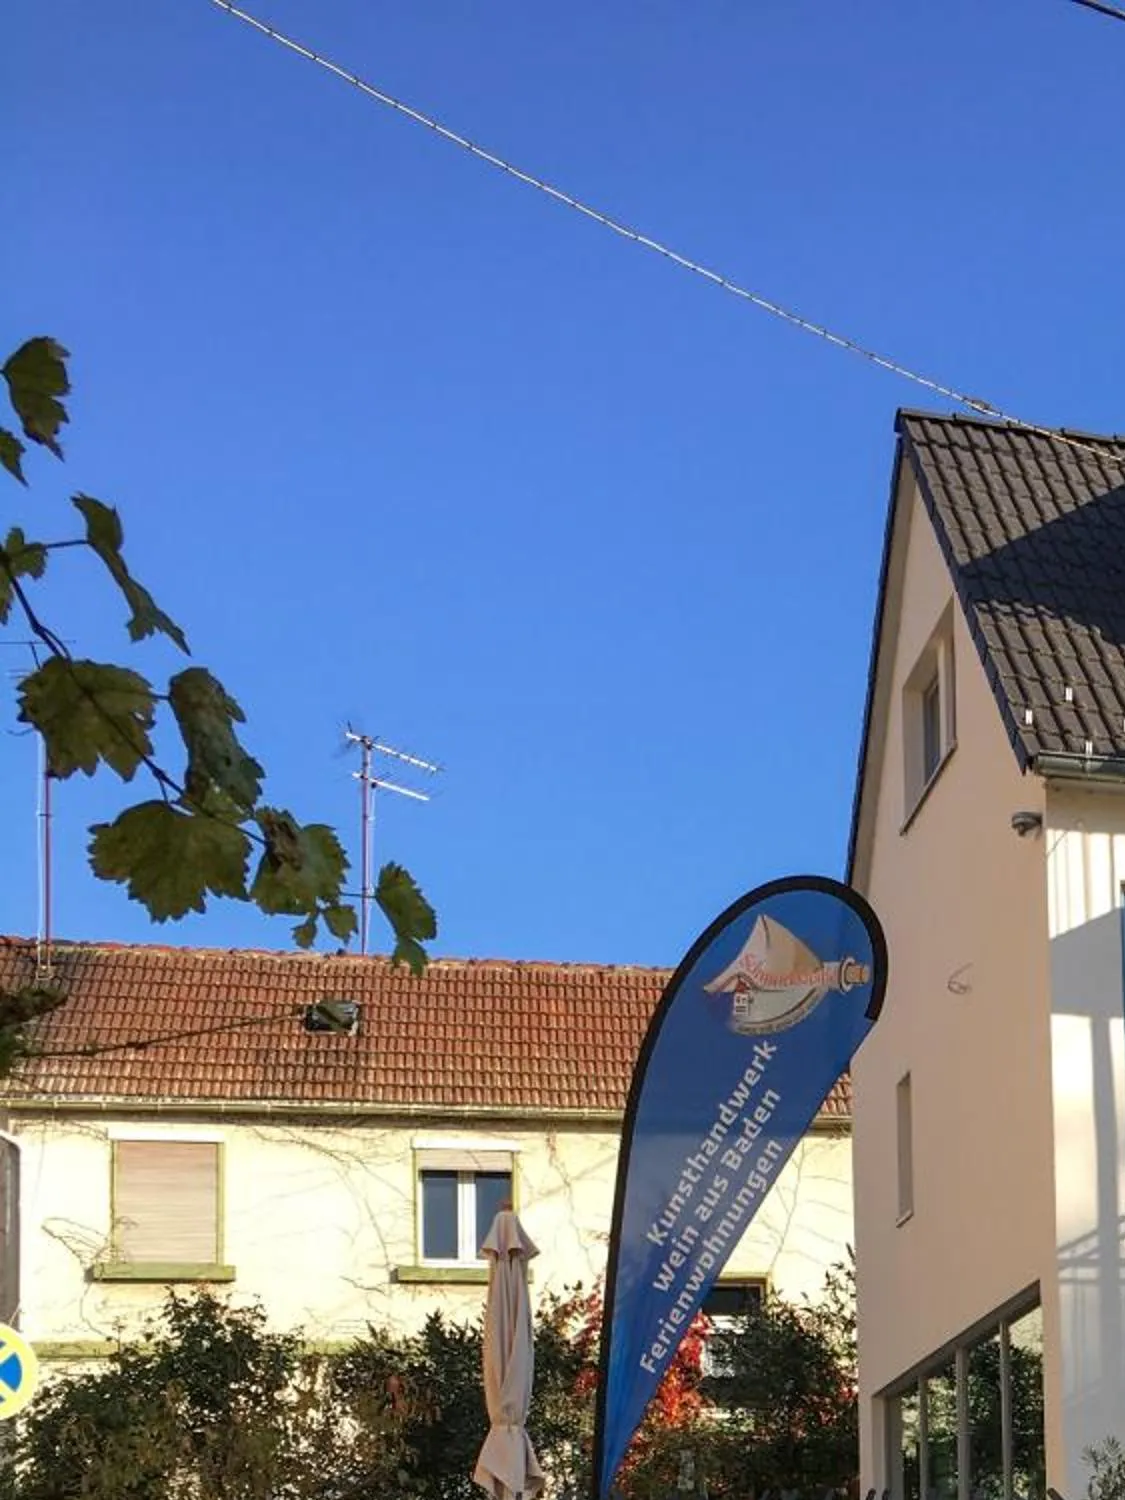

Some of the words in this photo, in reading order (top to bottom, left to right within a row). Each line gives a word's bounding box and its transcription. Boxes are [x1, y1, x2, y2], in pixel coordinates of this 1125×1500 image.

[647, 1040, 777, 1246] Kunsthandwerk
[653, 1224, 700, 1292] Wein
[694, 1175, 729, 1222] aus
[720, 1088, 782, 1171] Baden
[640, 1139, 783, 1374] Ferienwohnungen
